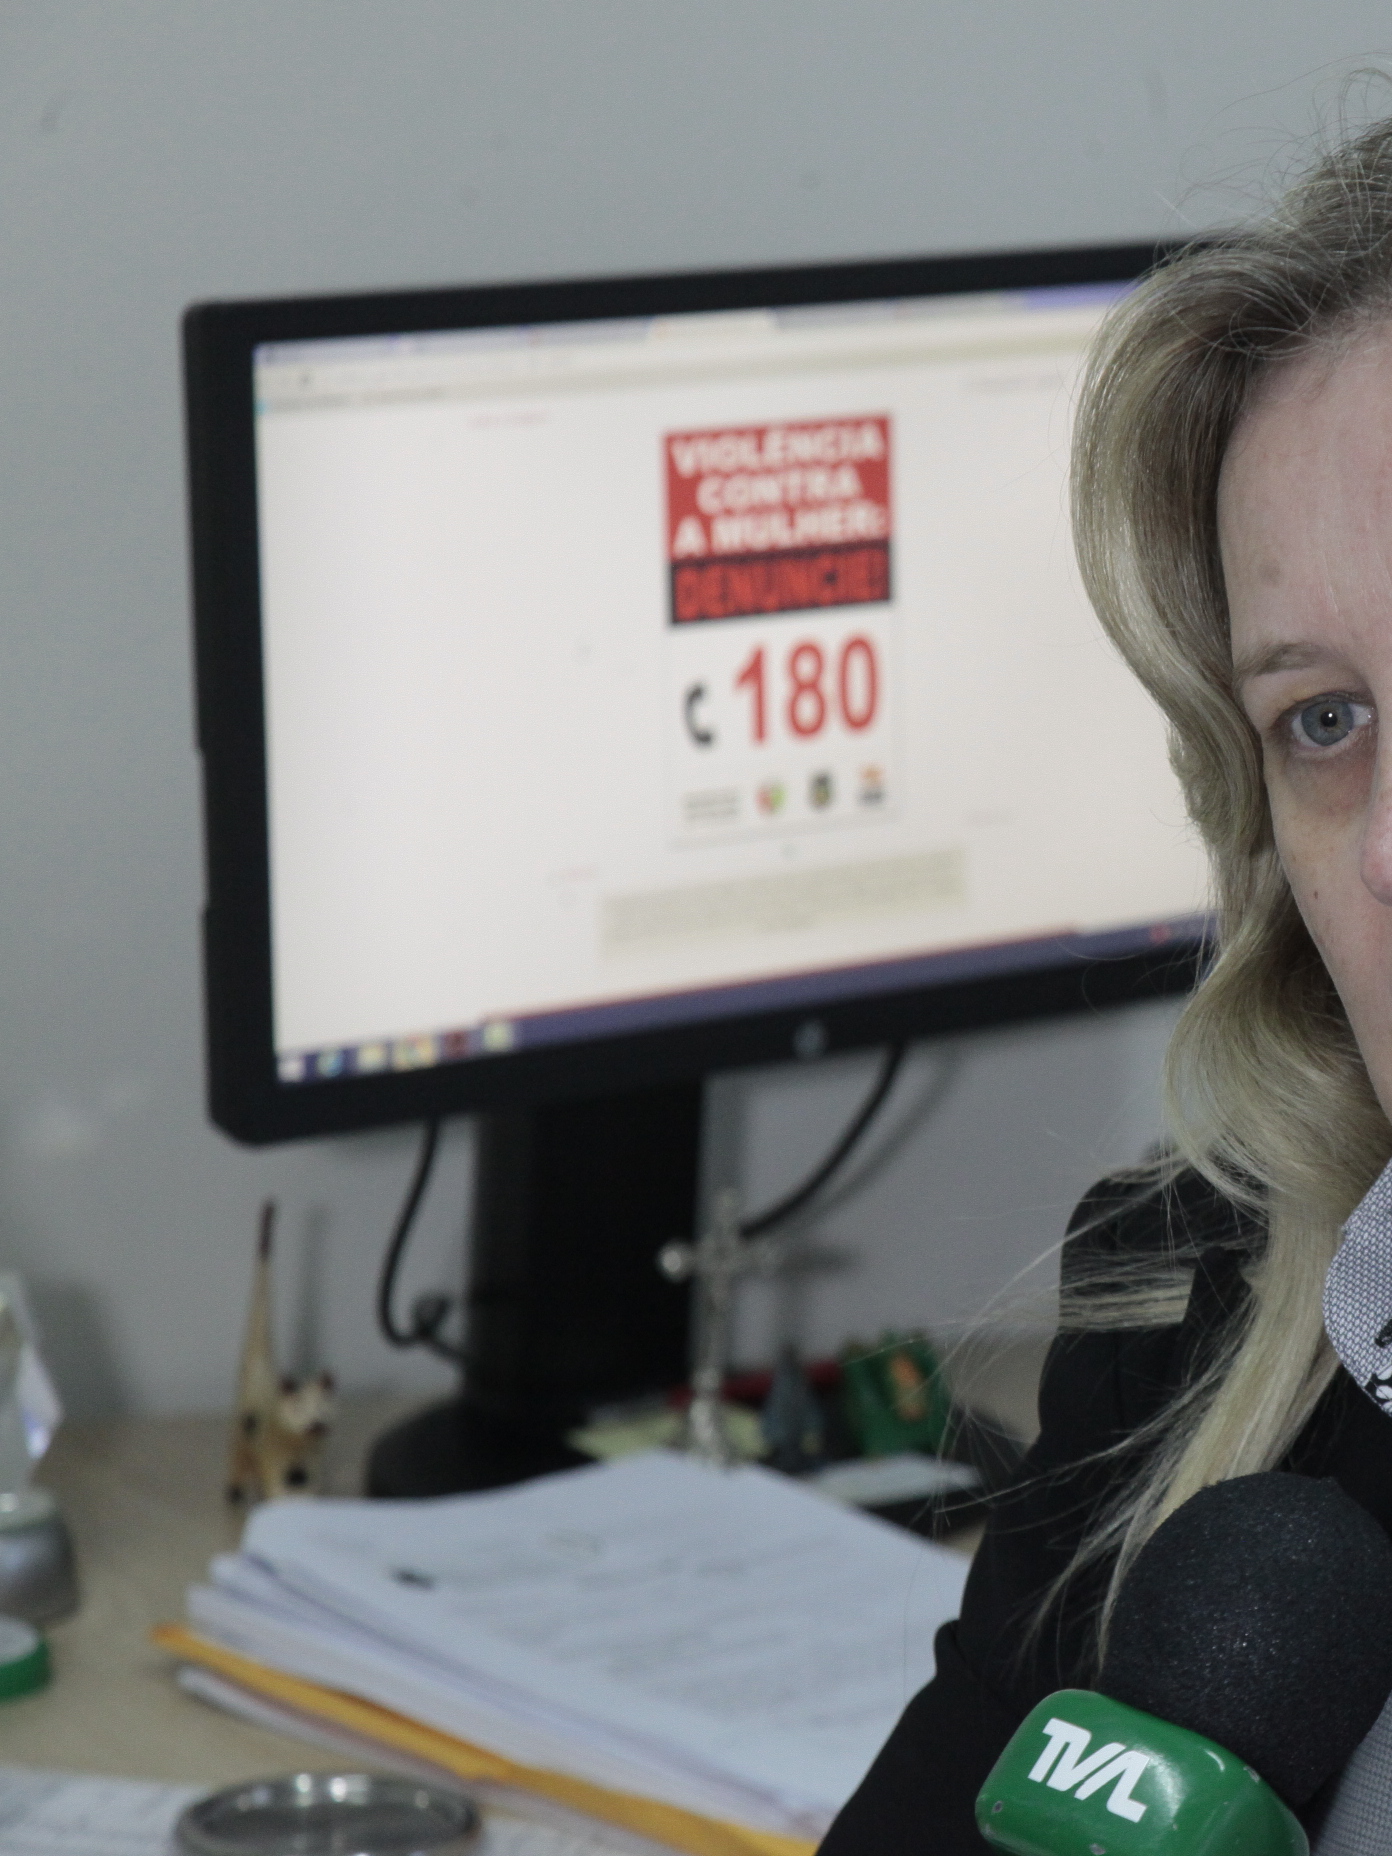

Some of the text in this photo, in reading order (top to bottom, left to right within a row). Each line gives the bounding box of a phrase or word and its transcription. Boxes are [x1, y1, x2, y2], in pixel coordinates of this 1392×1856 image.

[696, 464, 865, 516] CONTRA
[673, 516, 708, 560] A
[734, 633, 880, 746] 180
